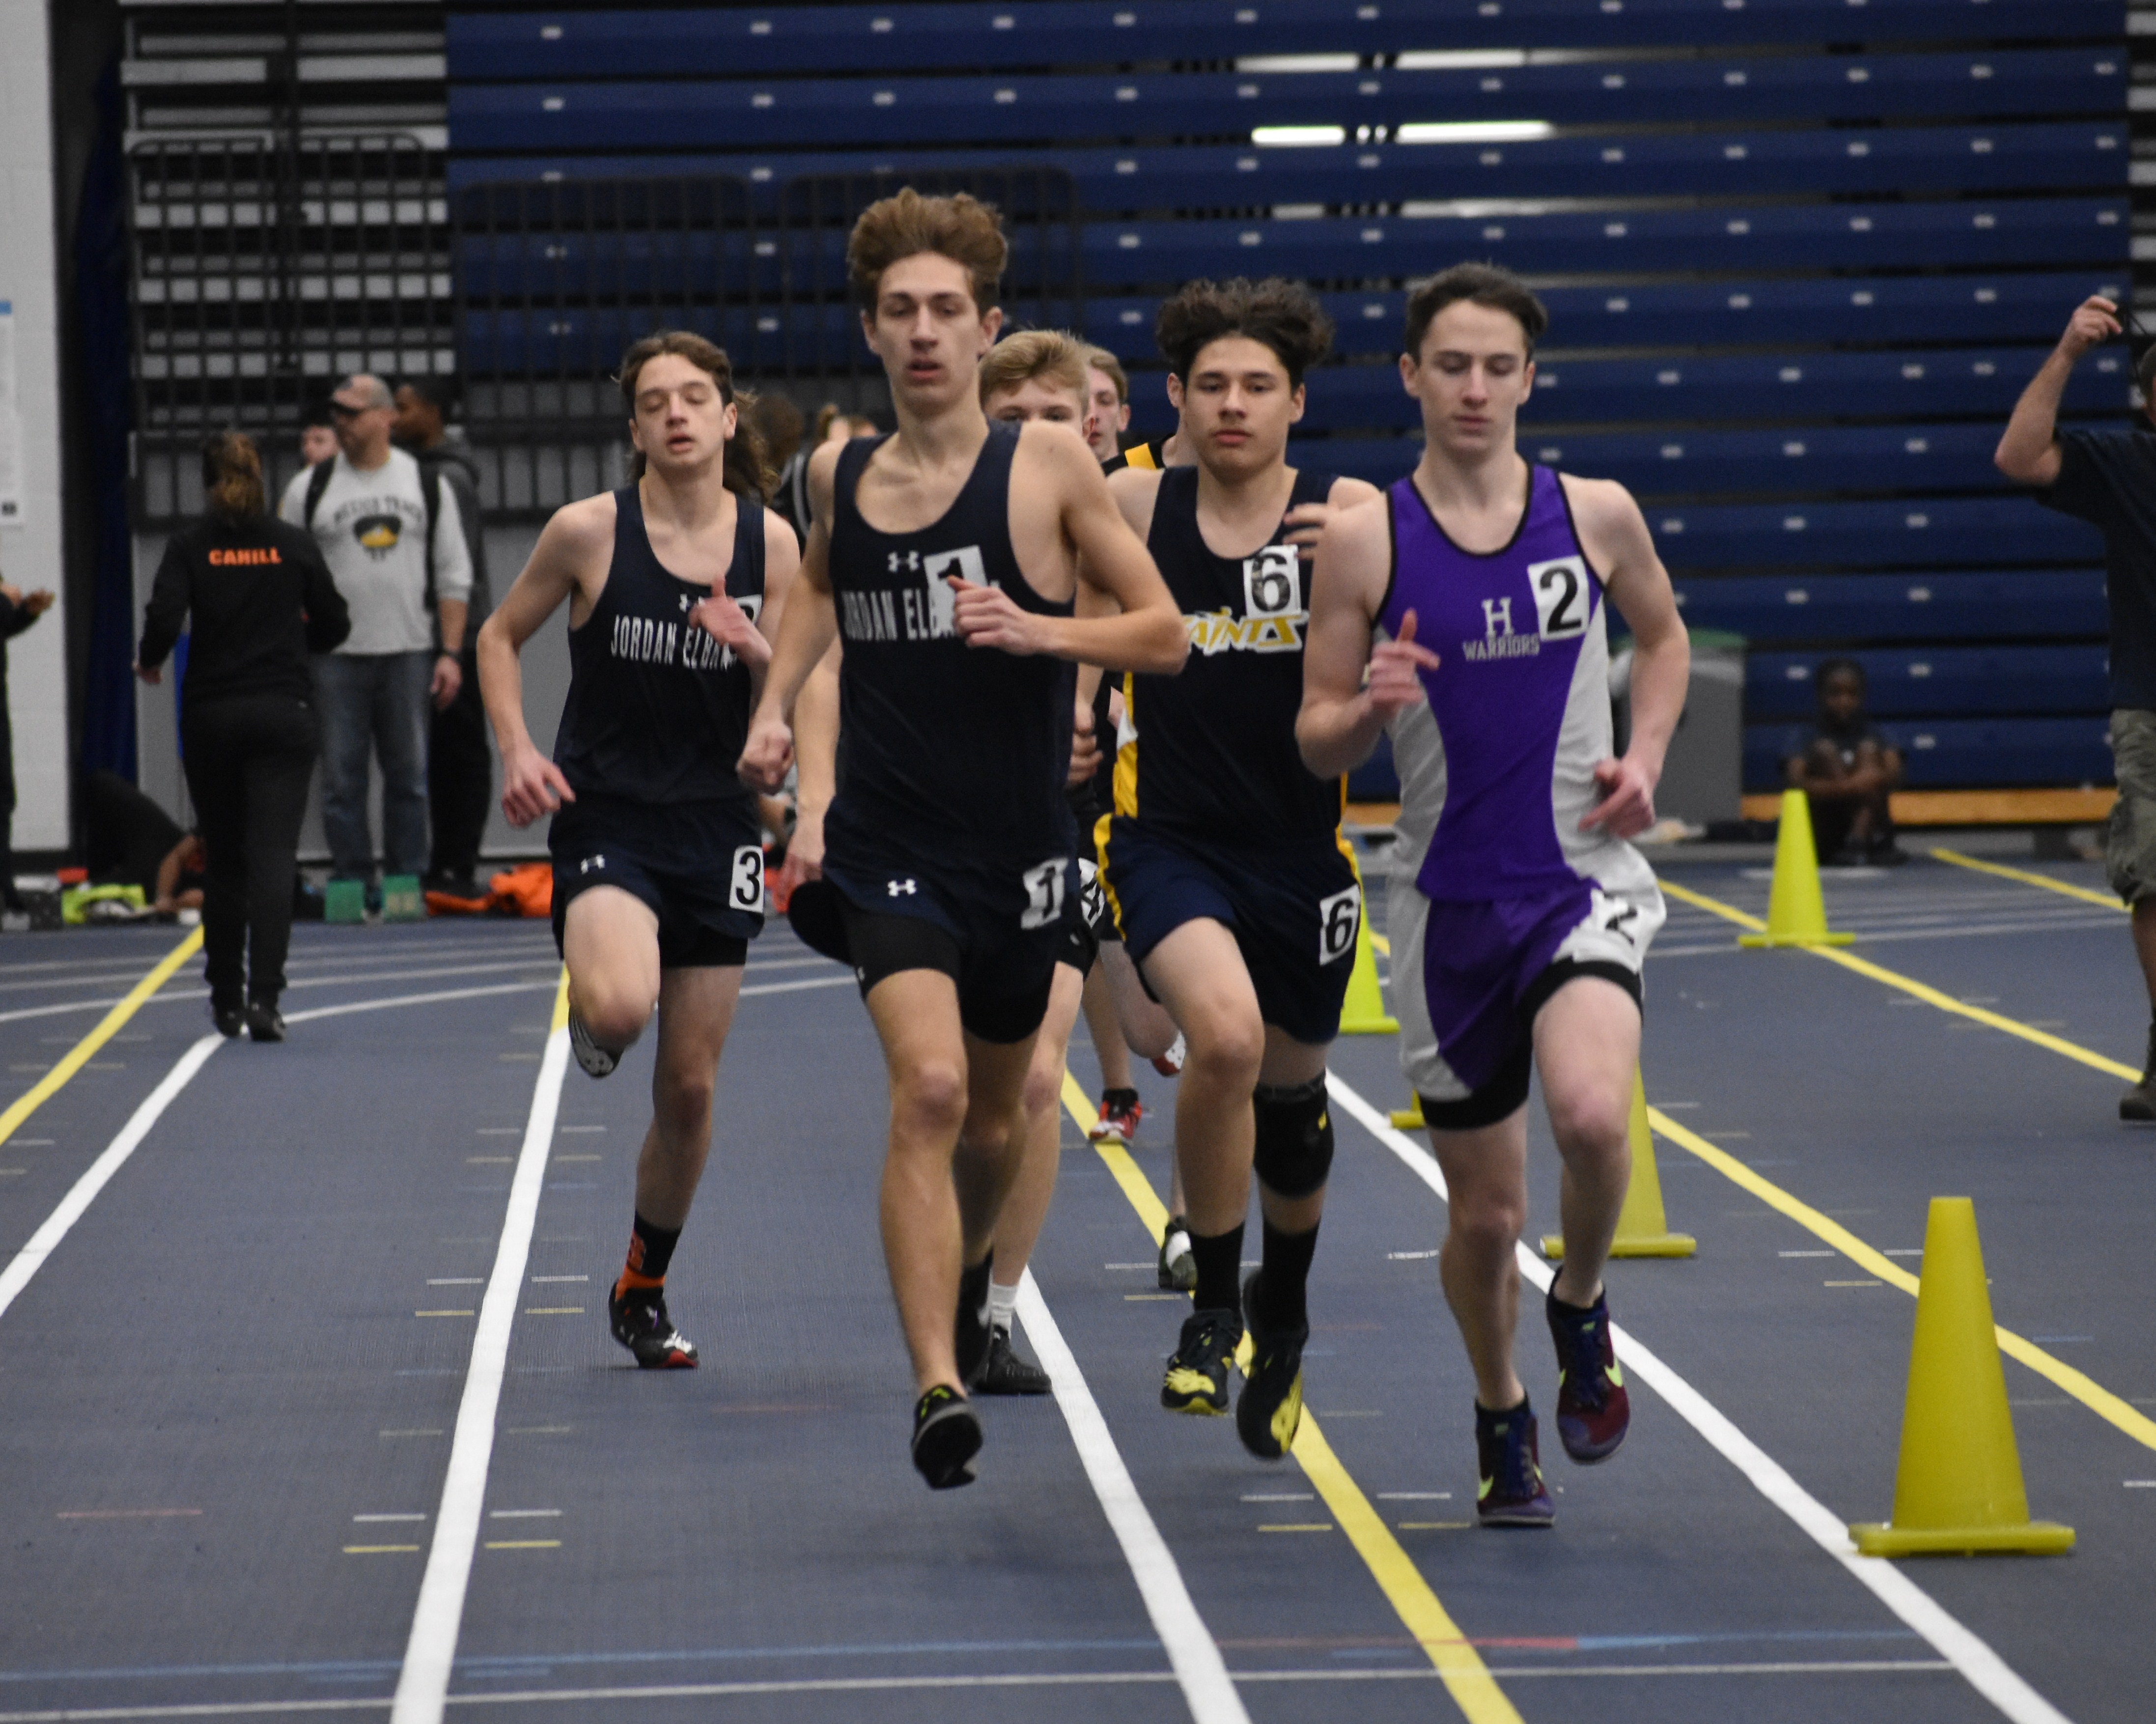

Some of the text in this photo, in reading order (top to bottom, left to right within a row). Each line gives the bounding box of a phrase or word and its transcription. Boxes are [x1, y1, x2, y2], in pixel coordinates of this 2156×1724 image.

[208, 546, 282, 566] CAHILL
[1251, 553, 1291, 612] 6
[1540, 566, 1582, 635] 2
[611, 614, 677, 665] JORDAN
[1182, 605, 1311, 656] AINTS
[1482, 596, 1514, 639] H
[1462, 632, 1540, 661] WARRIORS
[736, 851, 761, 904] 3
[1036, 866, 1056, 919] 1
[1326, 899, 1353, 953] 6
